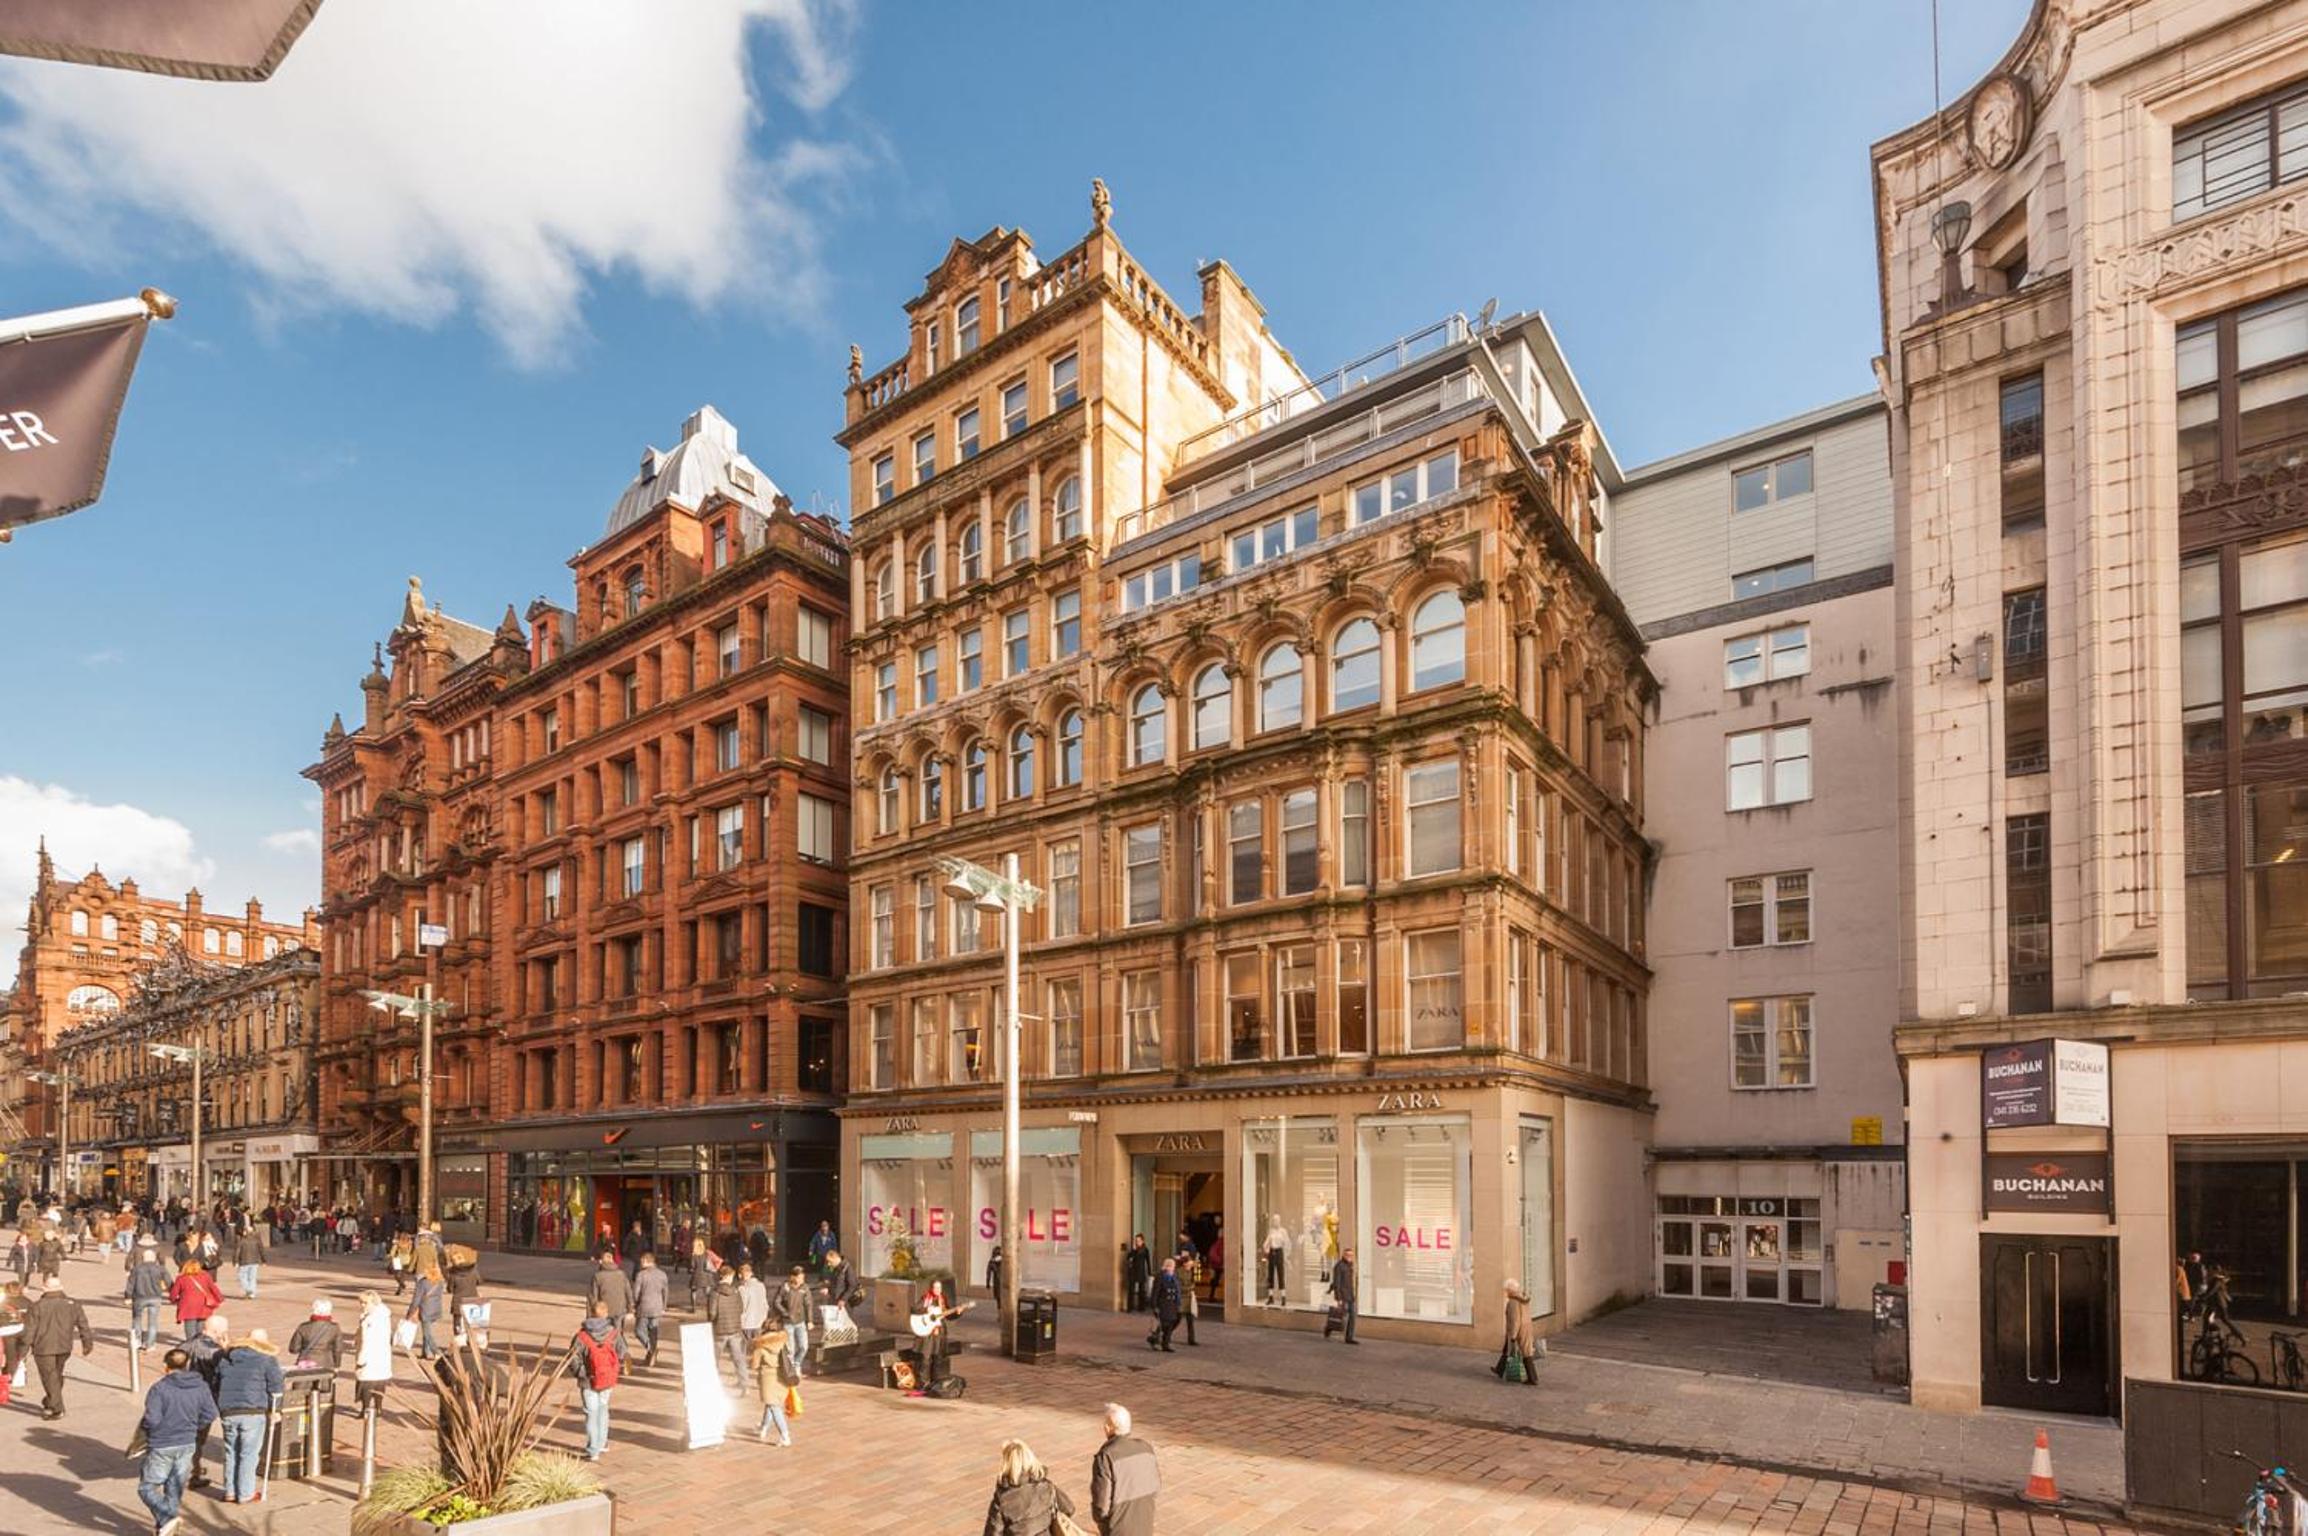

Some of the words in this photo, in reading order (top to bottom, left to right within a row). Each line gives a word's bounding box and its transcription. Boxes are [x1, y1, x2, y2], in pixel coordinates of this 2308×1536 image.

[1417, 1008, 1459, 1021] ZARA
[1988, 1059, 2043, 1079] BUCHANAN
[1378, 1091, 1442, 1110] ZARA
[886, 1116, 918, 1131] ZARA
[1156, 1135, 1205, 1151] ZARA
[1993, 1178, 2104, 1193] BUCHANAN
[1747, 1200, 1775, 1215] 10
[980, 1207, 1070, 1241] SLE
[1375, 1225, 1452, 1250] SALE
